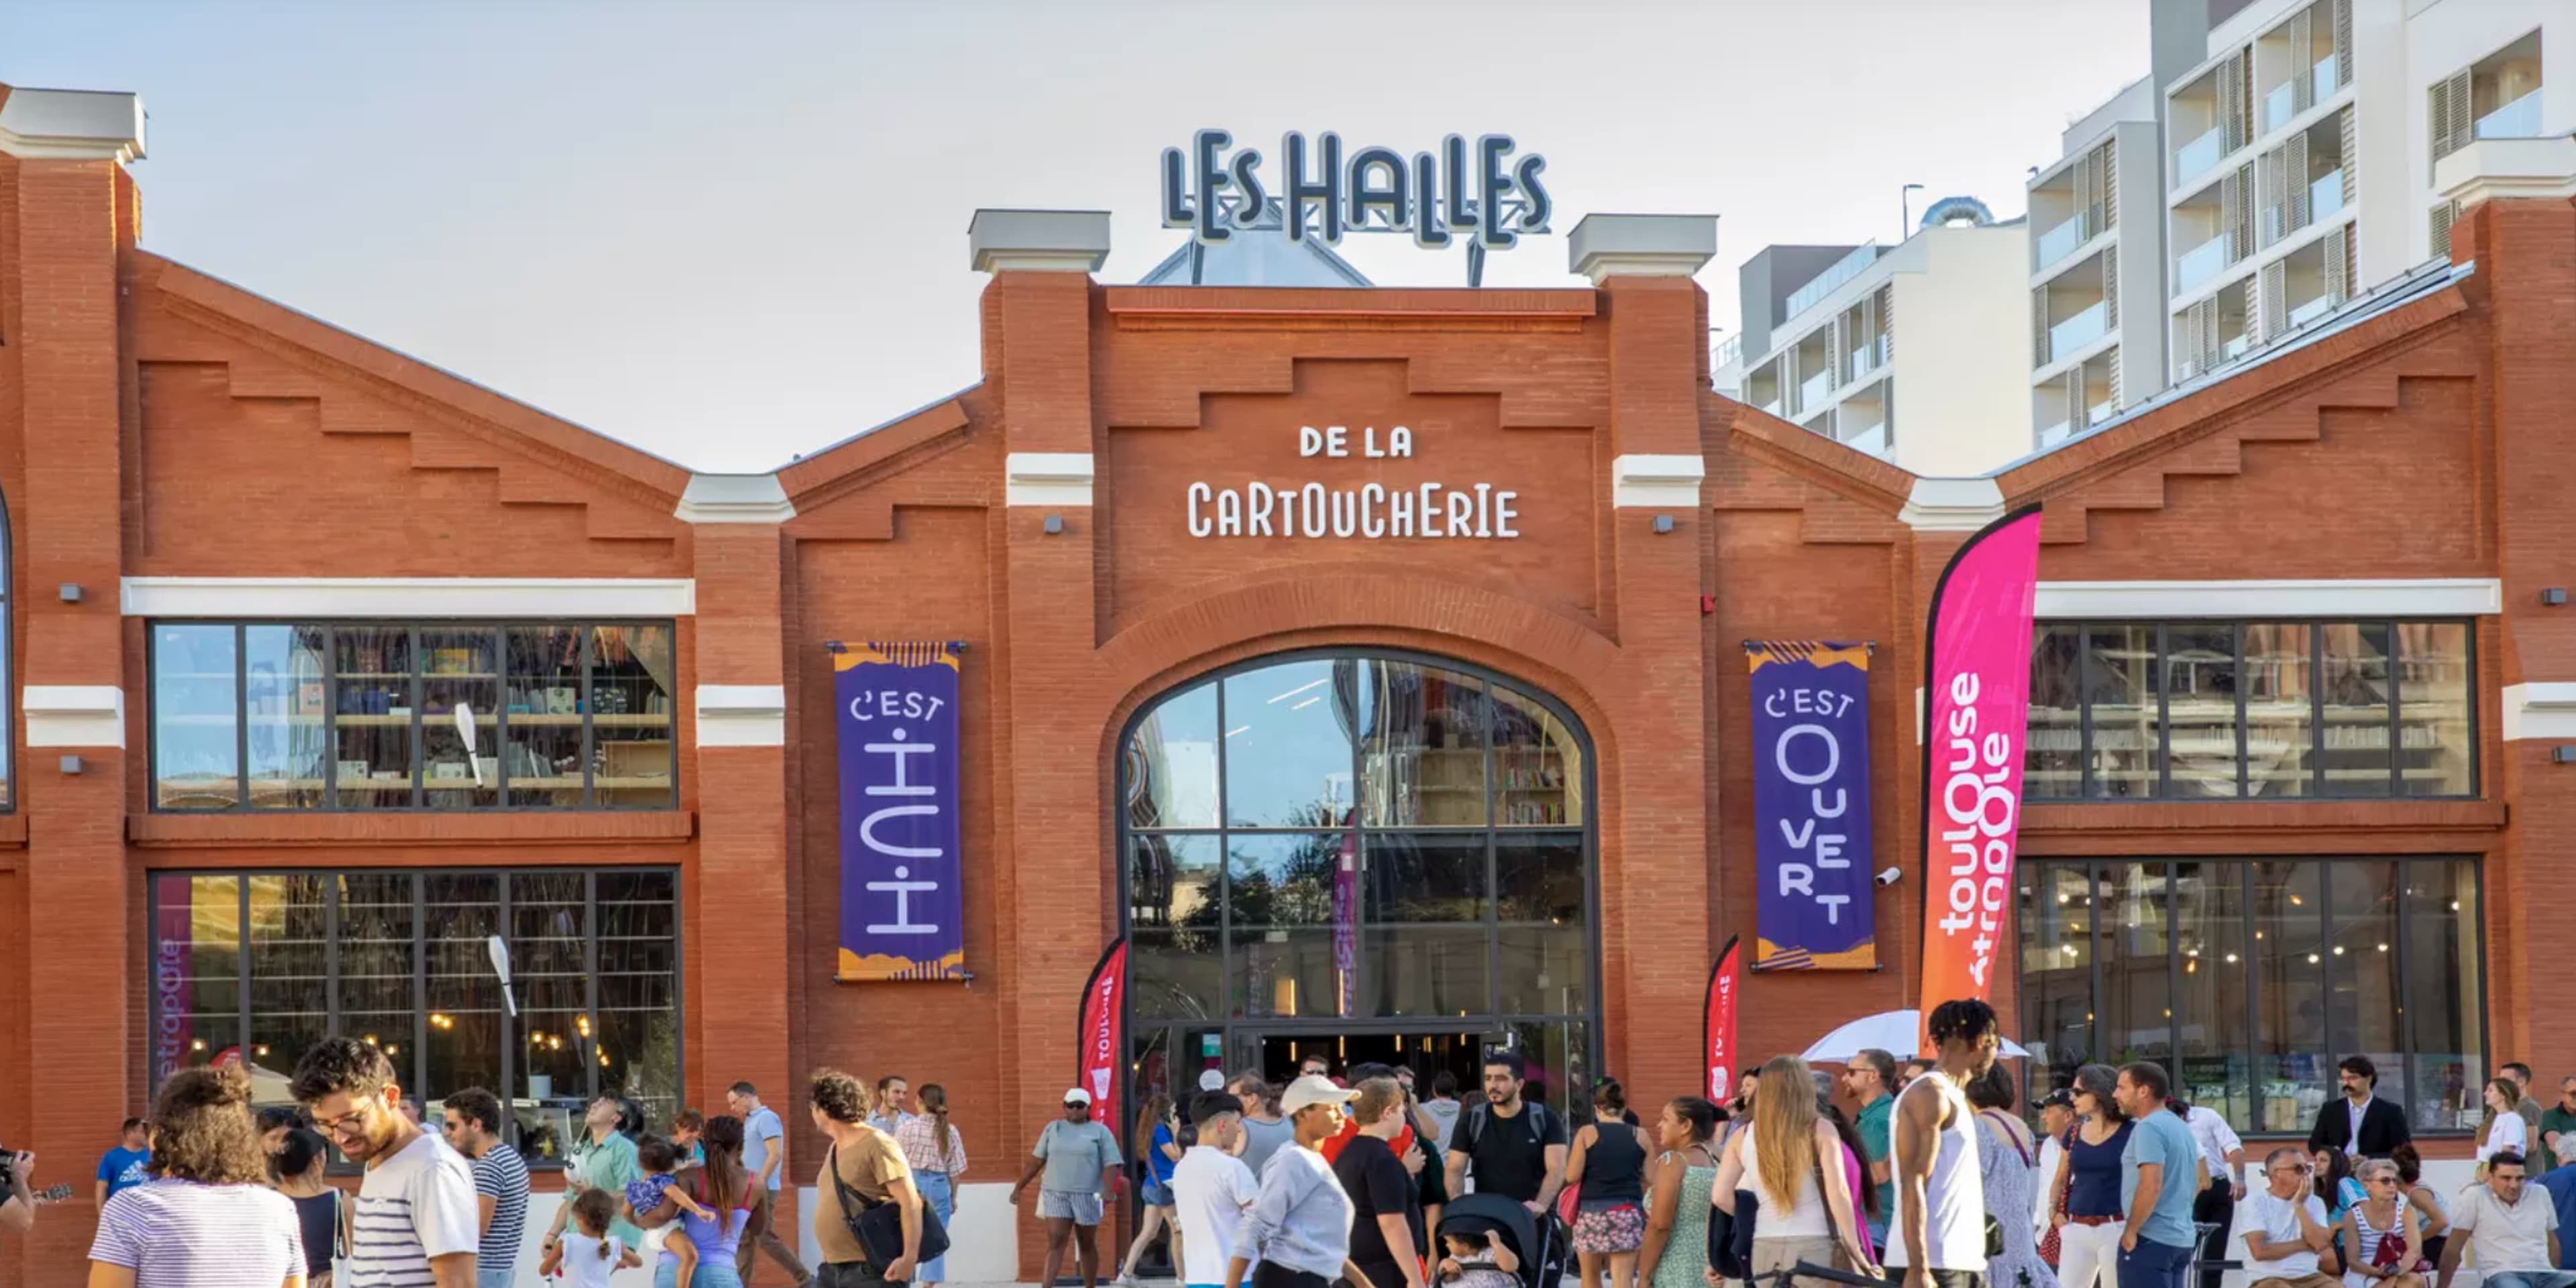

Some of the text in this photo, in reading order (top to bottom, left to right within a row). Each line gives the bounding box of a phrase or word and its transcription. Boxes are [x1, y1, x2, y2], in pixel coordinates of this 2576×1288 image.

[1161, 129, 1551, 249] LES HALLES
[1300, 426, 1411, 458] DE LA
[1187, 482, 1519, 538] CARTOUCHERIE
[850, 690, 945, 721] C'EST
[1765, 688, 1854, 718] C'EST
